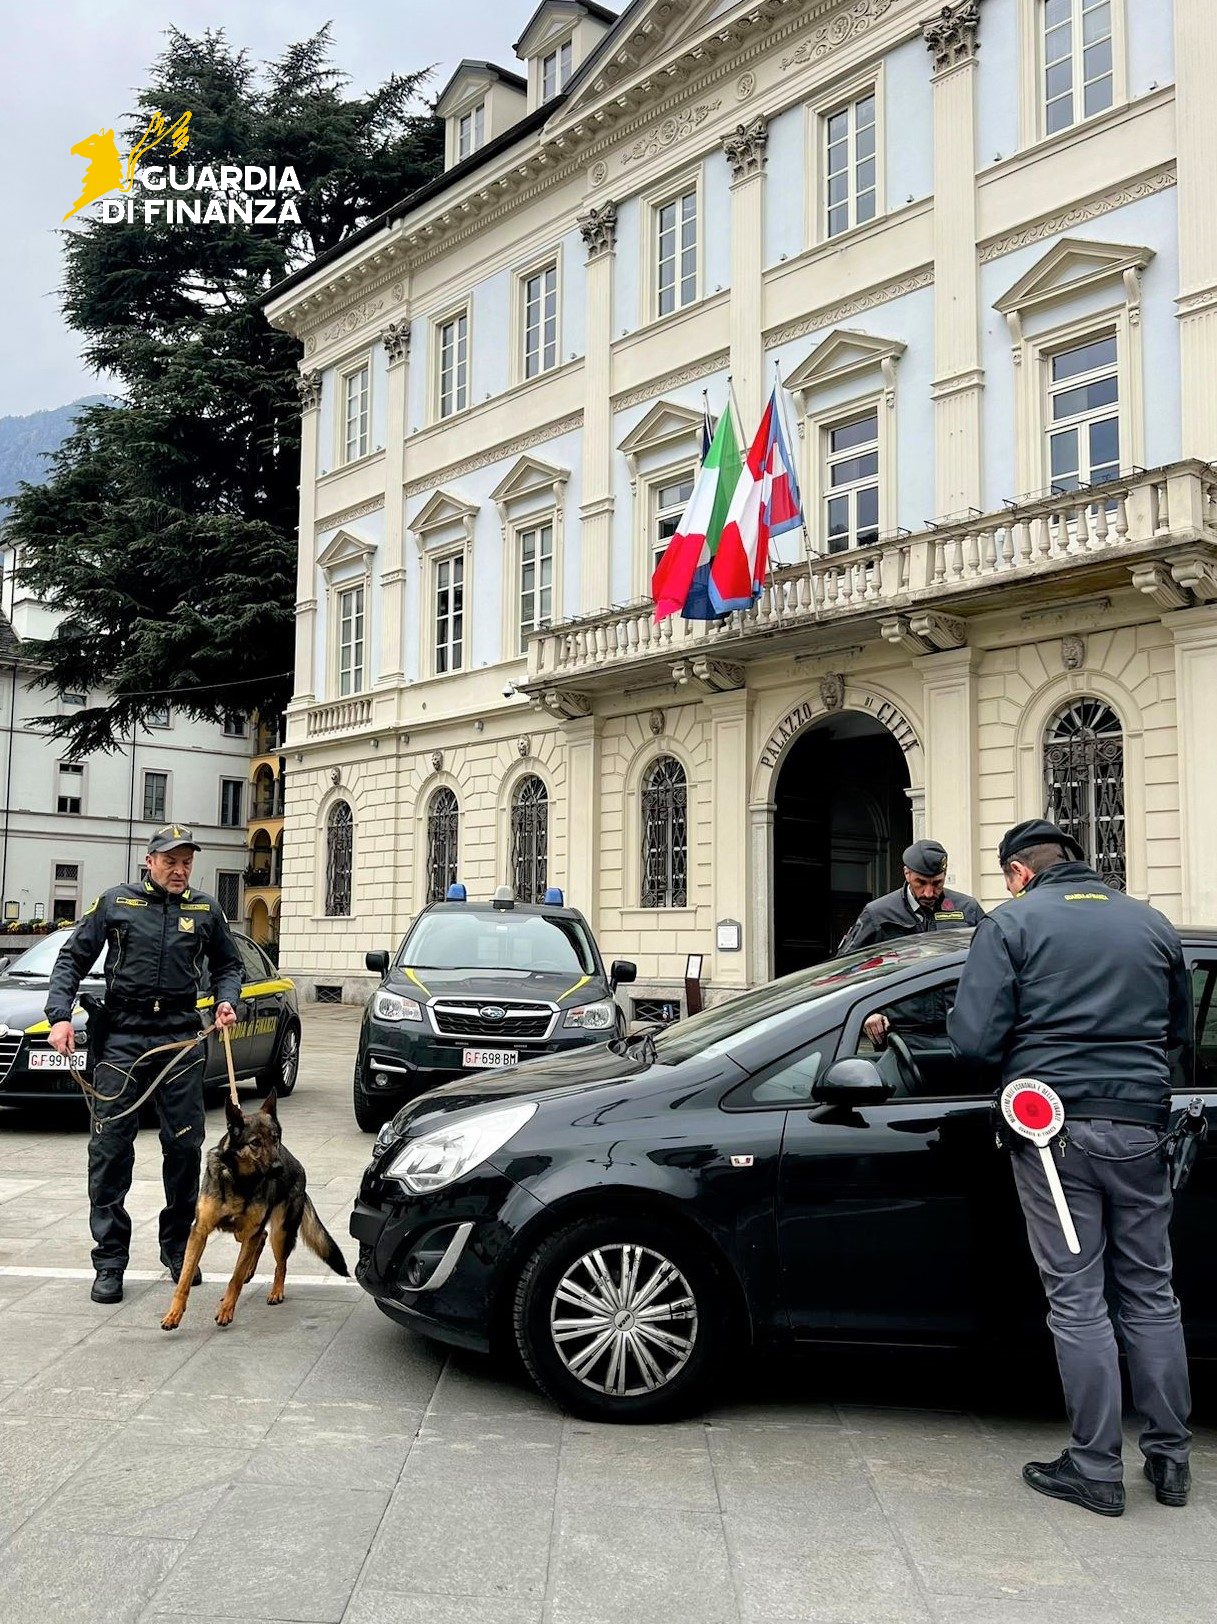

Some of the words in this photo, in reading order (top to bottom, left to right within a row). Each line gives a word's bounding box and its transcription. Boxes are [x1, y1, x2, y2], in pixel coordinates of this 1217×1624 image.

[761, 702, 812, 769] PALAZZO
[49, 1054, 68, 1067] 991
[482, 1052, 501, 1065] 698
[503, 1053, 517, 1066] BM
